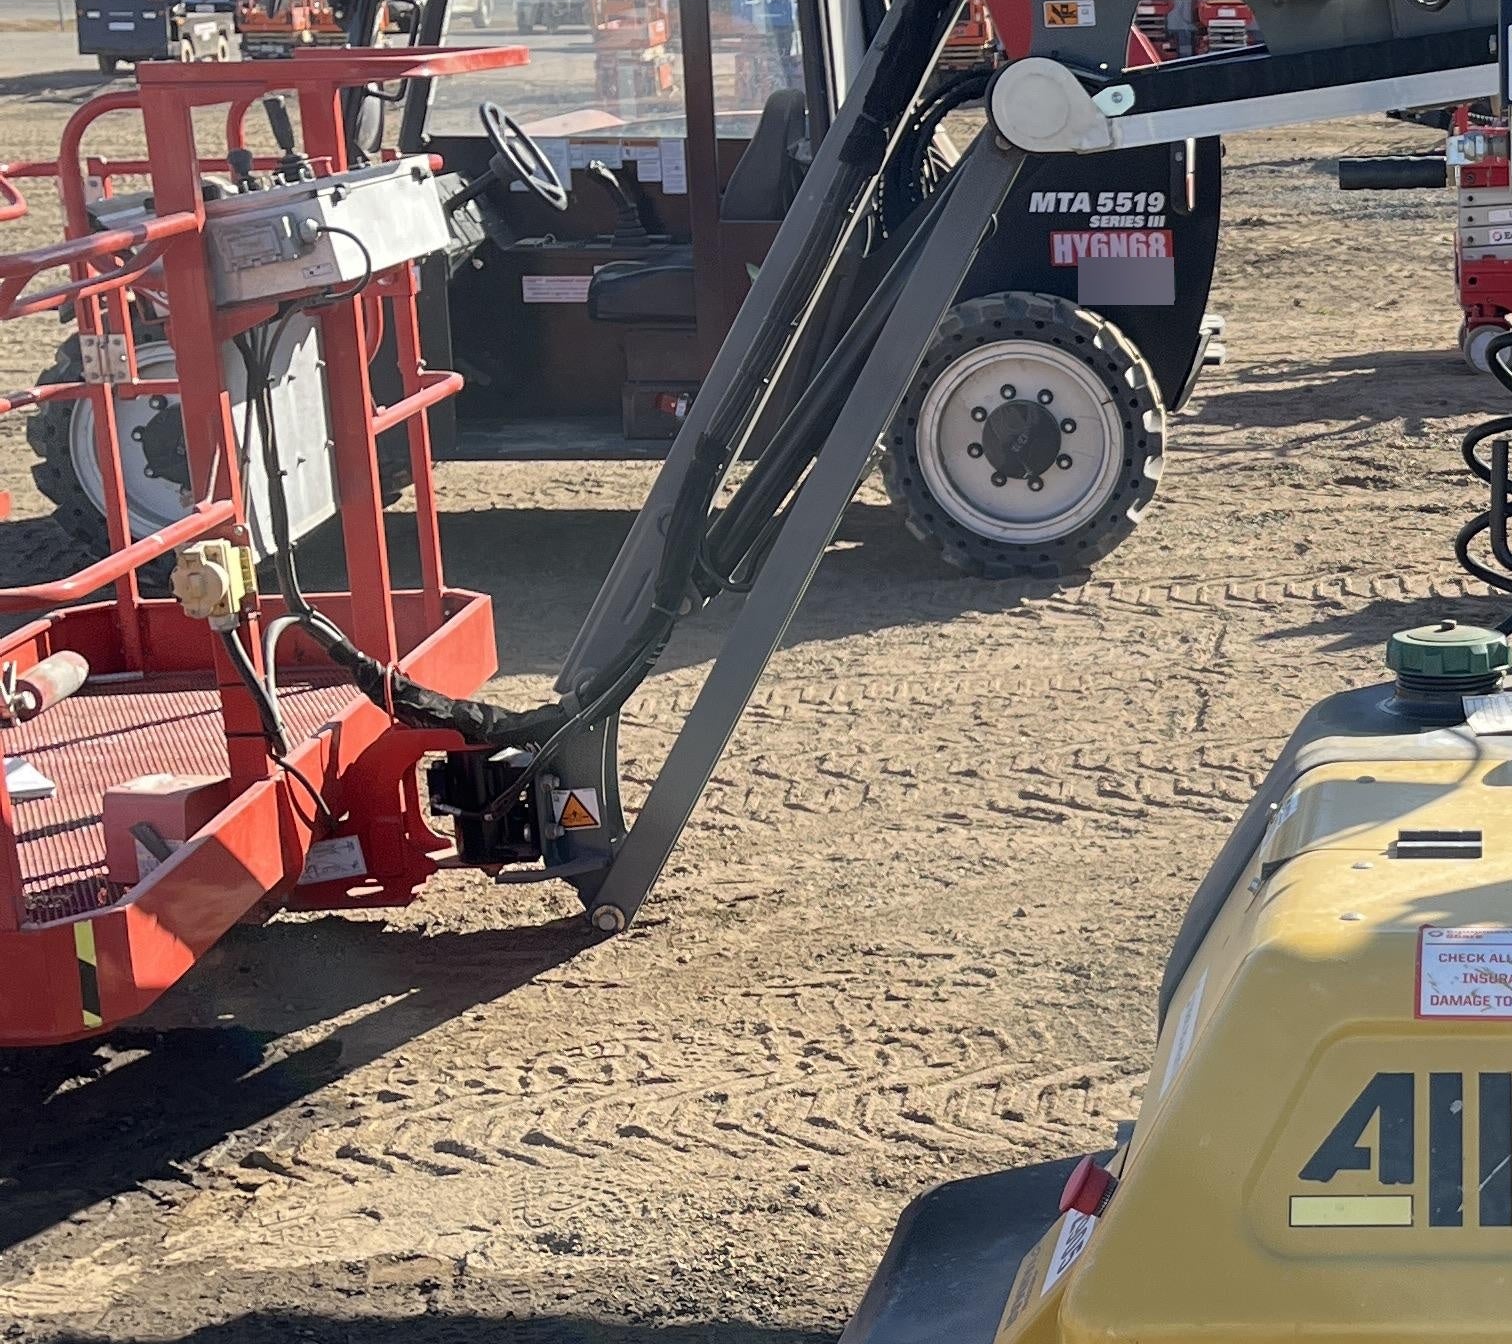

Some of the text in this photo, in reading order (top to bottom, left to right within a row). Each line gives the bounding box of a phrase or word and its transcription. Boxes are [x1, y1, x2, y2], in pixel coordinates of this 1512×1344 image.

[1028, 191, 1166, 214] MTA 5519
[1088, 215, 1166, 228] SERIES III
[1438, 953, 1485, 964] CHECK
[1489, 953, 1512, 964] ALL
[1429, 994, 1490, 1007] DAMAGE
[1495, 995, 1512, 1007] TO
